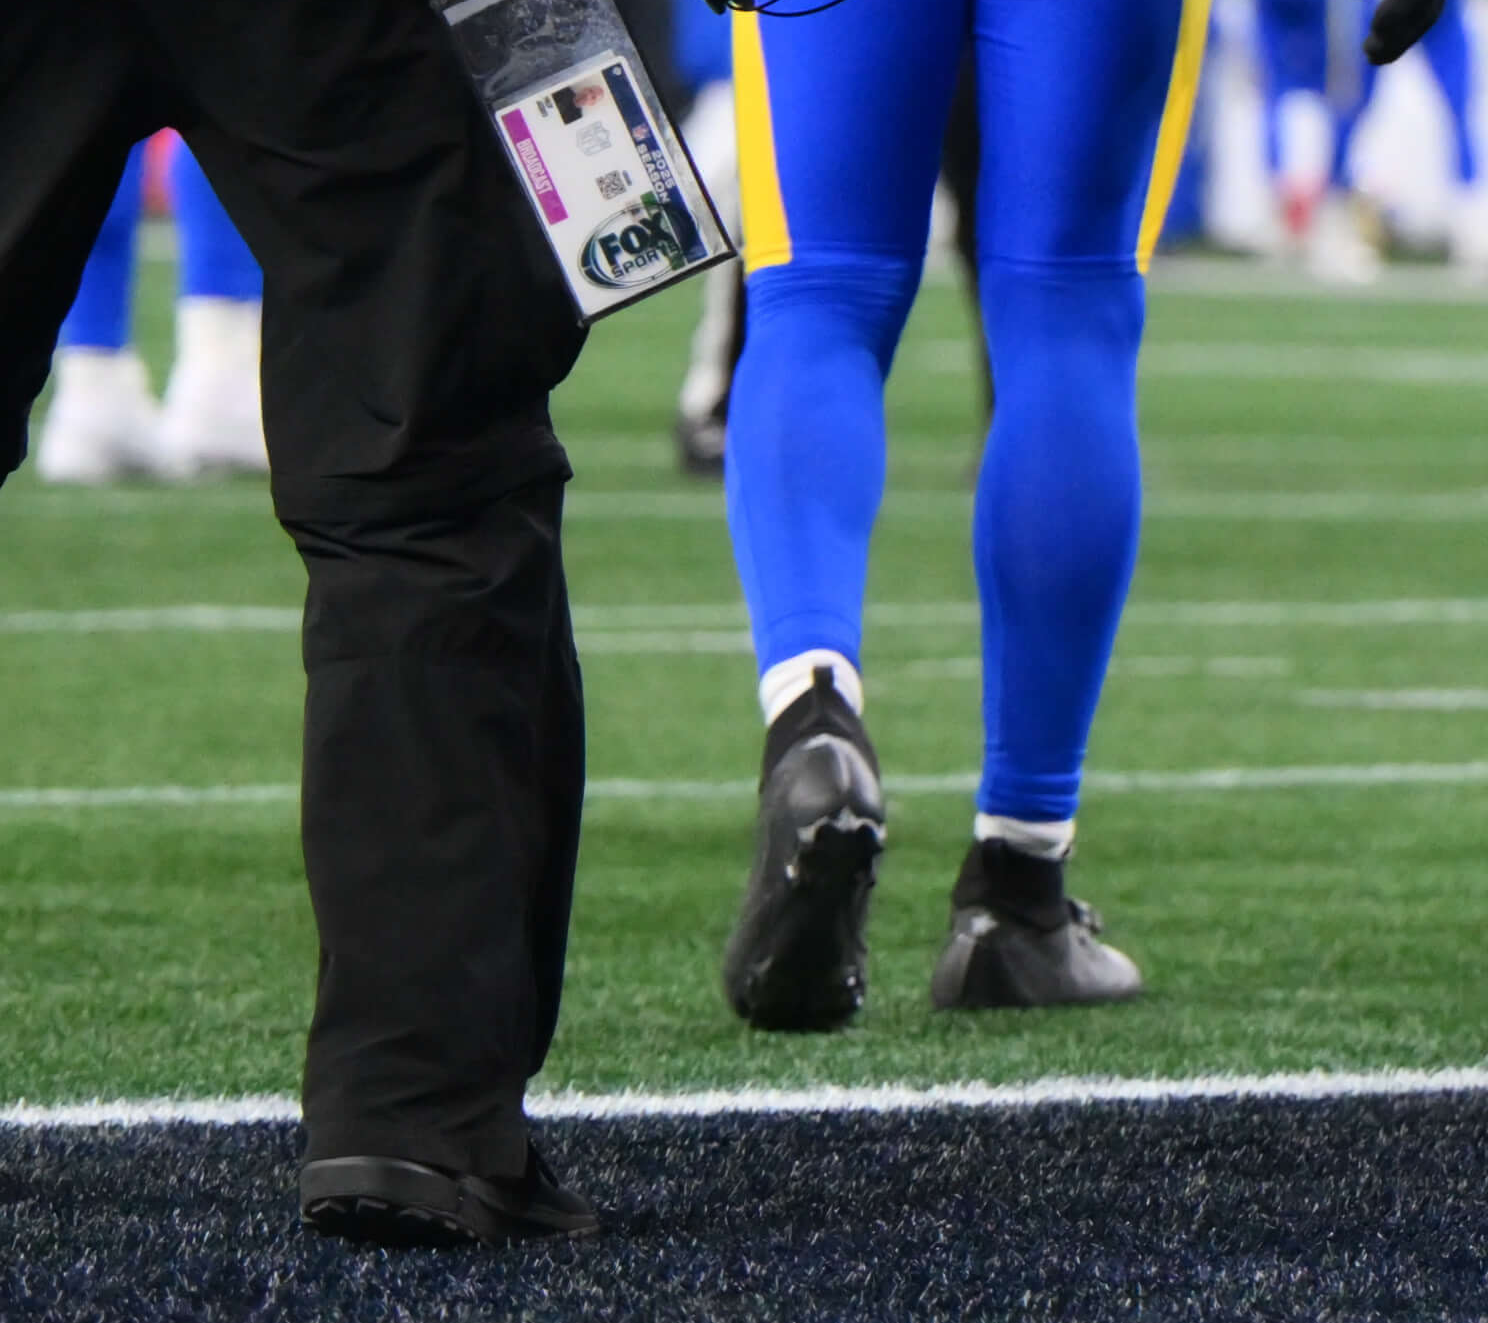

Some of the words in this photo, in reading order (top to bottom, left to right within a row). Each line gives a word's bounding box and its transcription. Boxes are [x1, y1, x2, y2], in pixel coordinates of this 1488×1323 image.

[516, 137, 553, 195] BROADCAST
[637, 144, 671, 204] SEASON
[598, 211, 677, 269] FOX
